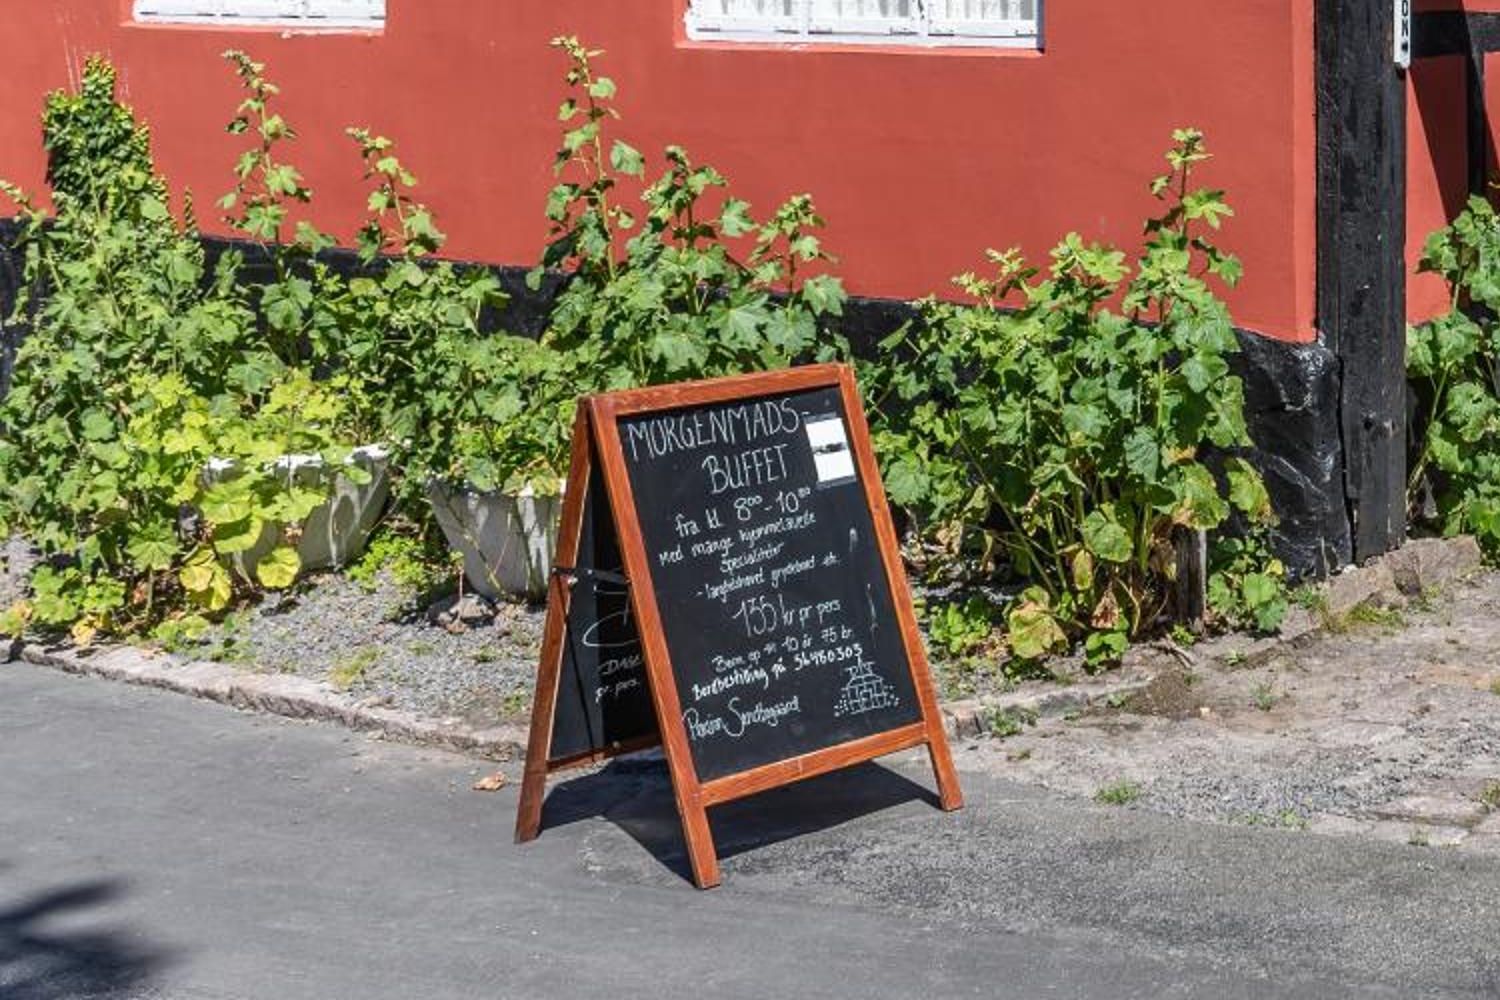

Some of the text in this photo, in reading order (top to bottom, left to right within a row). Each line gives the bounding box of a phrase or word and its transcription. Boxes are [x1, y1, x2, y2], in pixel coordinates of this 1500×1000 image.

[702, 444, 788, 494] BUFFET
[675, 513, 700, 538] fra
[691, 536, 735, 558] mange
